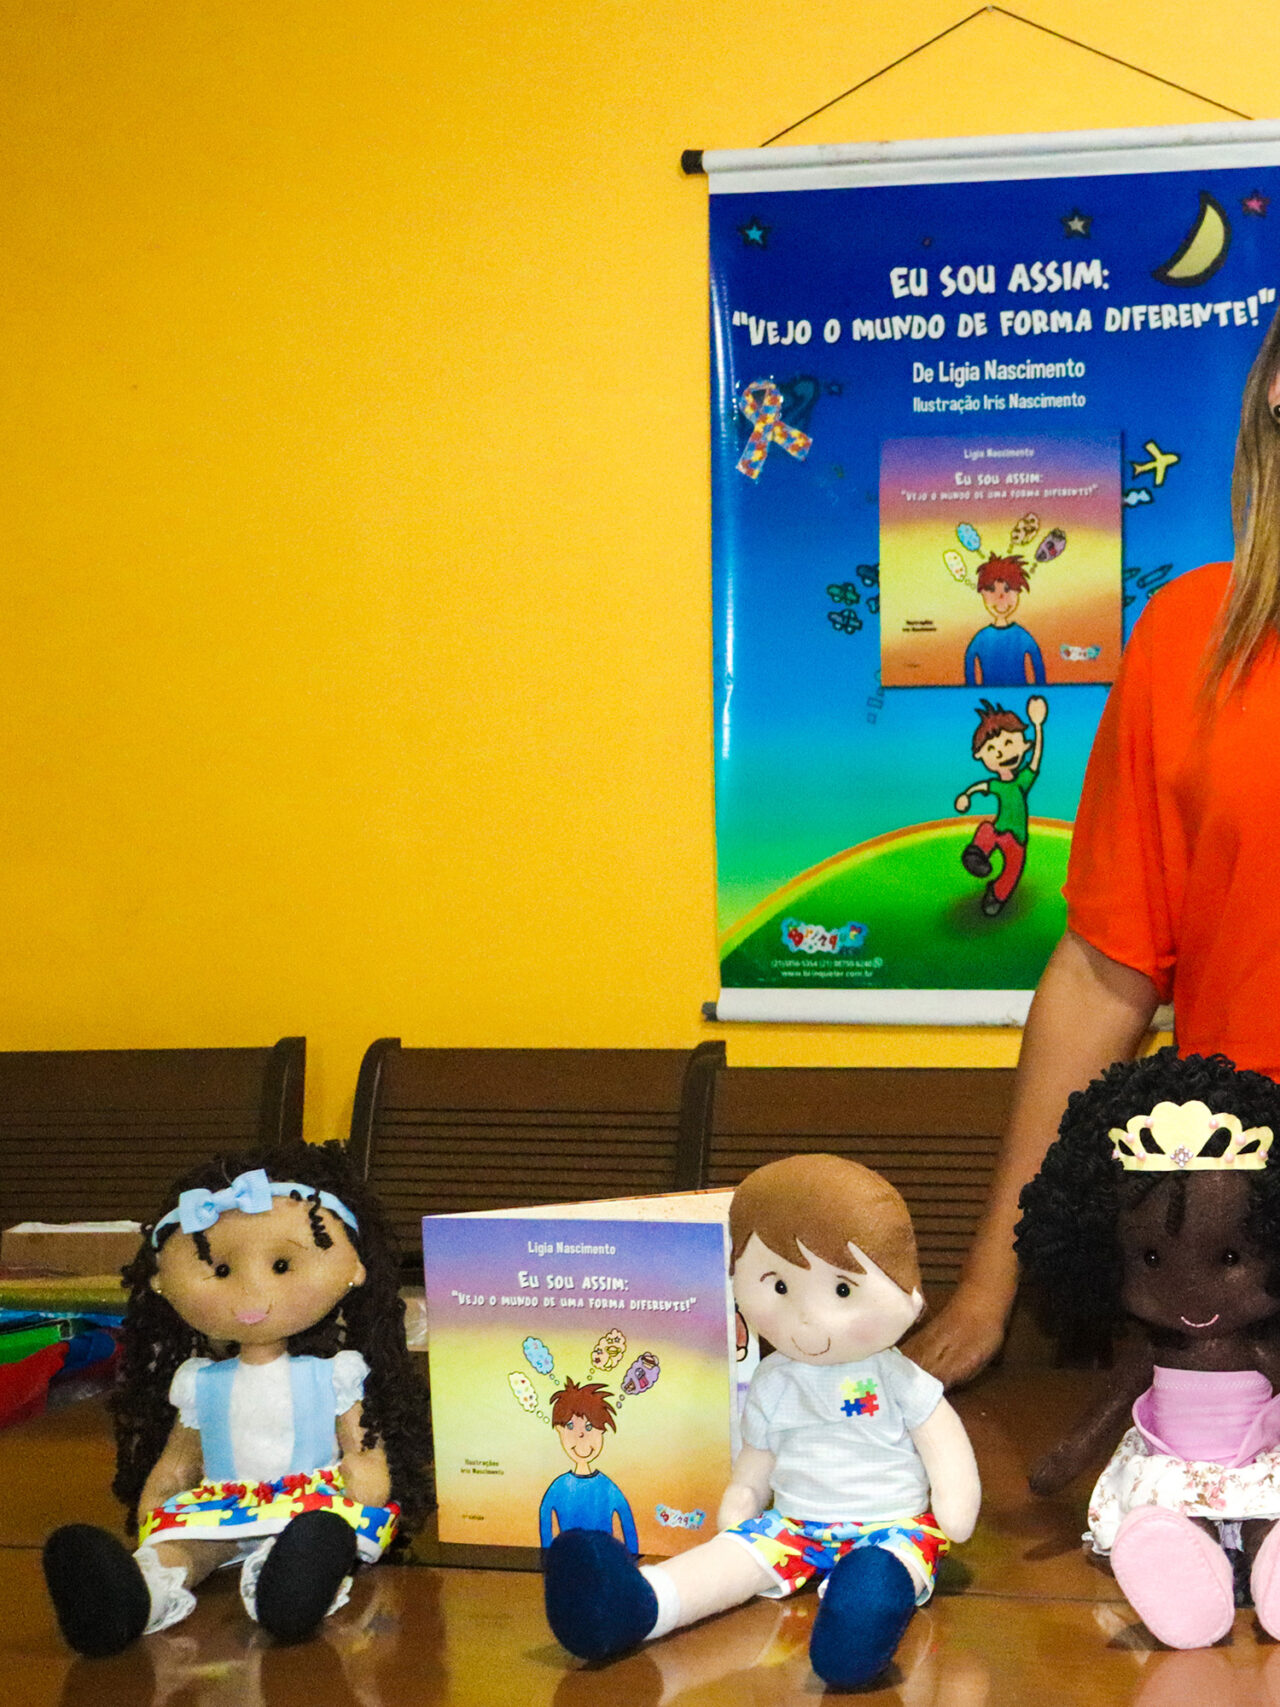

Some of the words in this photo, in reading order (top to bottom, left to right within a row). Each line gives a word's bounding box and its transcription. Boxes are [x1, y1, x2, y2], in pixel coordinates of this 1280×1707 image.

[890, 266, 928, 299] EU
[939, 264, 996, 298] SOU
[1007, 258, 1110, 294] ASSIM:
[823, 318, 841, 344] O
[852, 314, 946, 342] MUNDO
[957, 312, 988, 338] DE
[1000, 308, 1092, 337] FORMA
[913, 361, 934, 384] De
[938, 360, 980, 388] Ligia
[984, 358, 1086, 381] Nascimento
[913, 395, 981, 415] Ilustração
[983, 394, 1005, 411] Iris
[1008, 391, 1086, 409] Nascimento
[528, 1240, 553, 1256] Ligia
[556, 1241, 616, 1255] Nascimento
[501, 1296, 539, 1307] MUNDO
[543, 1296, 556, 1307] DE
[560, 1297, 584, 1308] UMA
[588, 1298, 625, 1309] FORMA
